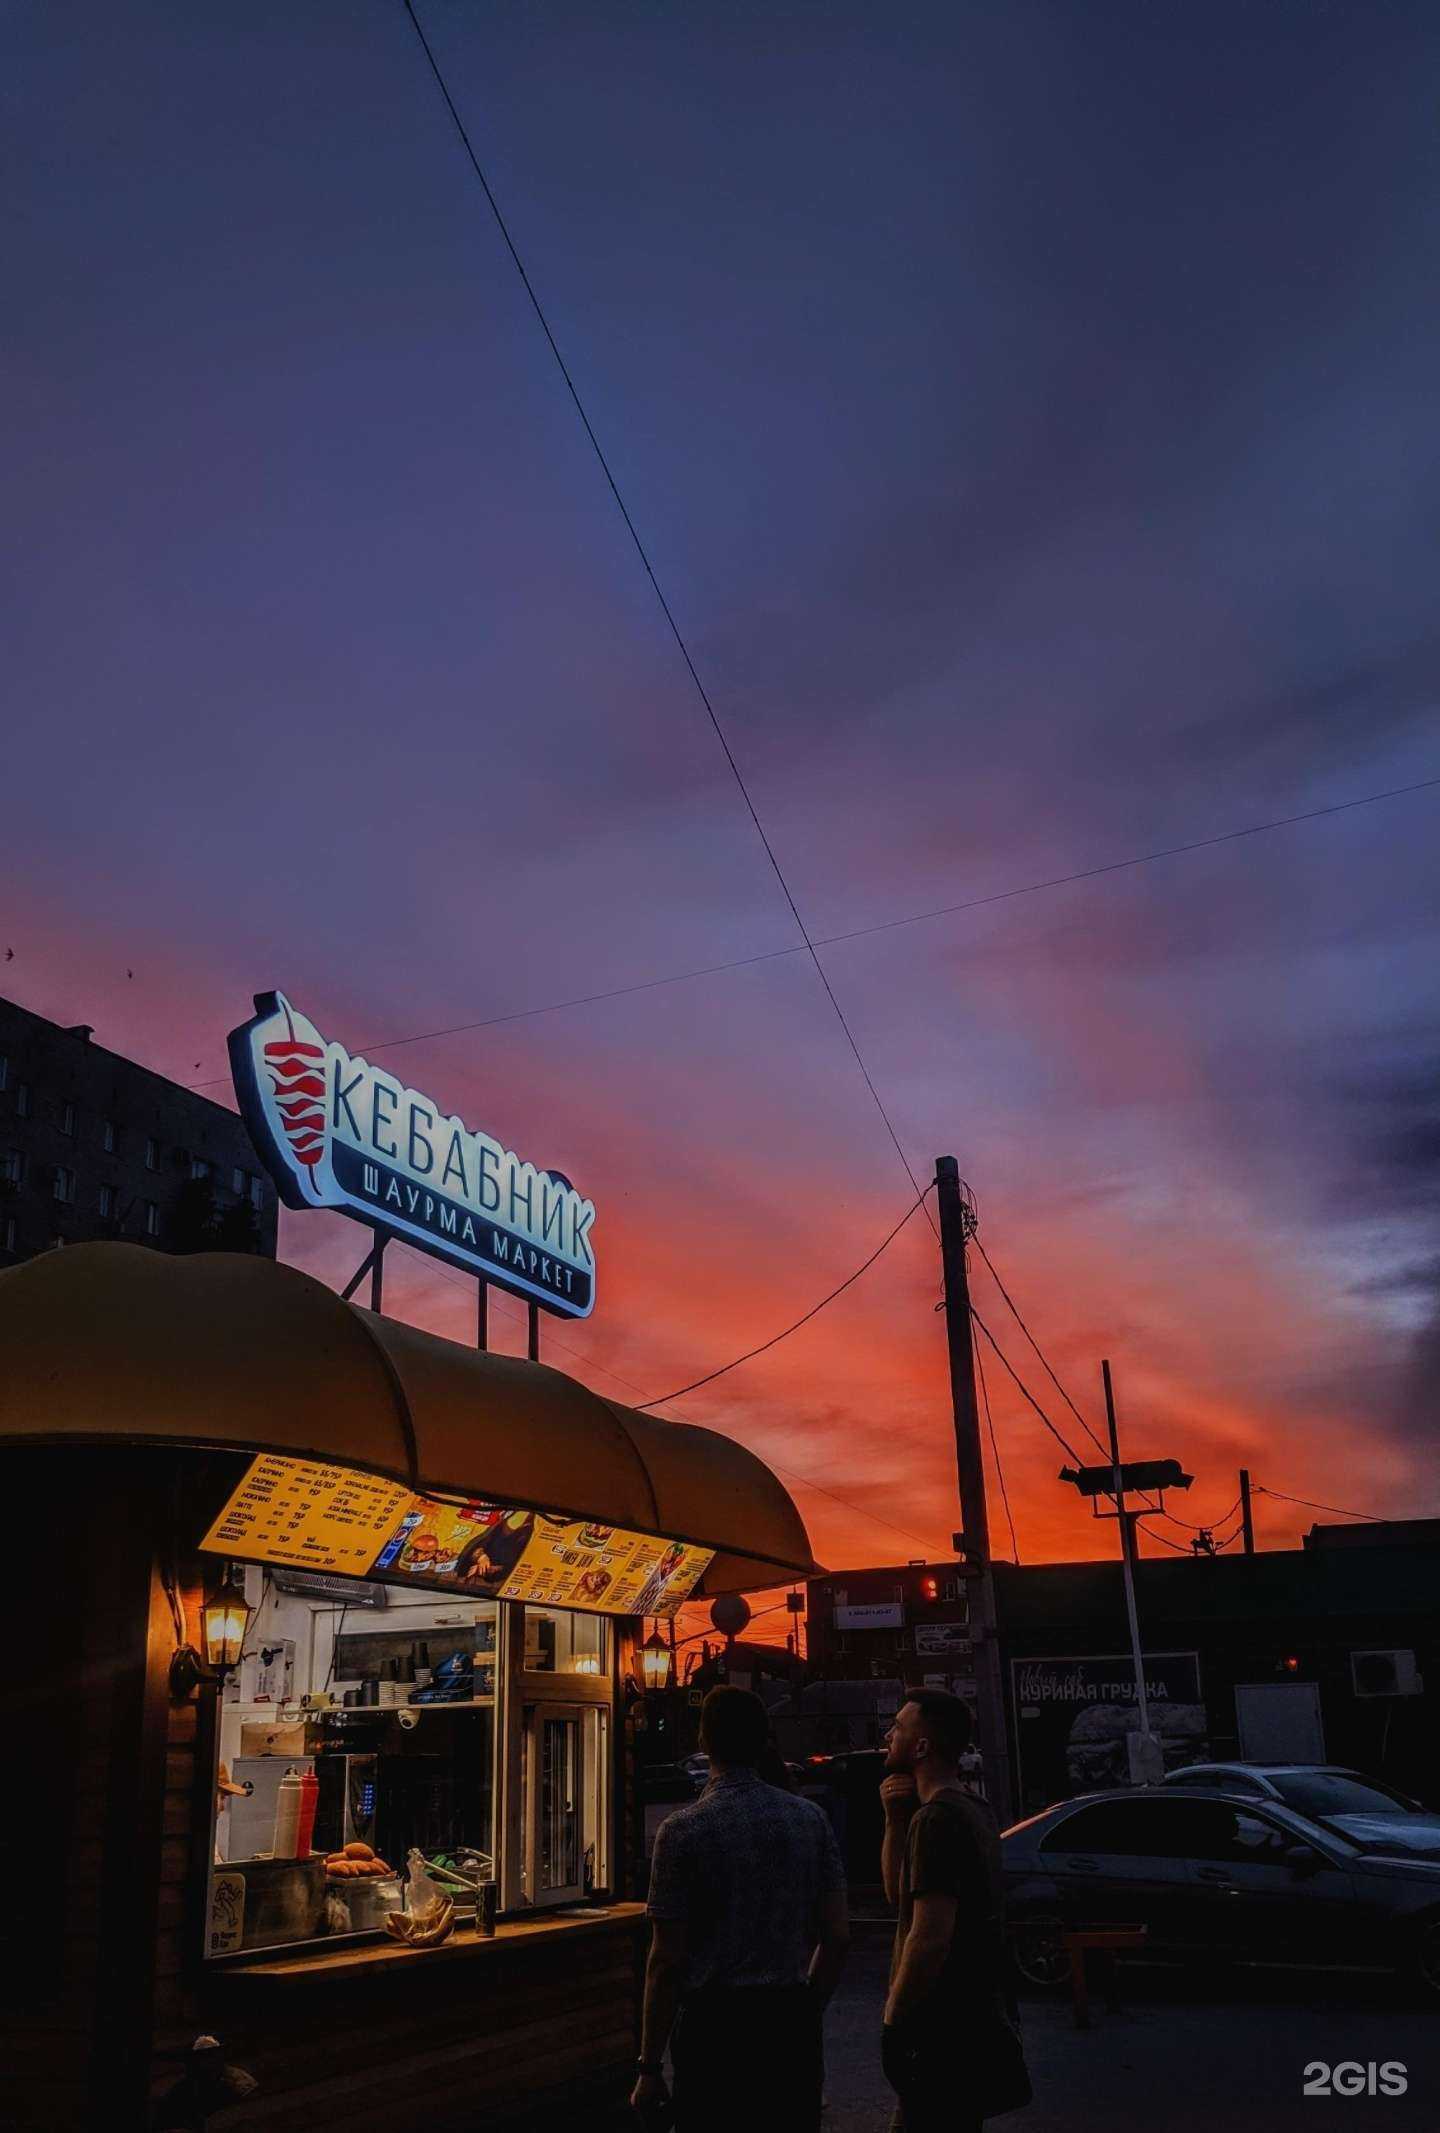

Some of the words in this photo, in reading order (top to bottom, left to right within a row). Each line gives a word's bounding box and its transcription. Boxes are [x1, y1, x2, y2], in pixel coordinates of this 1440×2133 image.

[332, 1058, 593, 1267] КЕБАБНИК
[362, 1163, 478, 1246] ШАУРМА
[493, 1230, 574, 1294] МАРКЕТ
[1020, 1683, 1097, 1702] КУРИНАЯ
